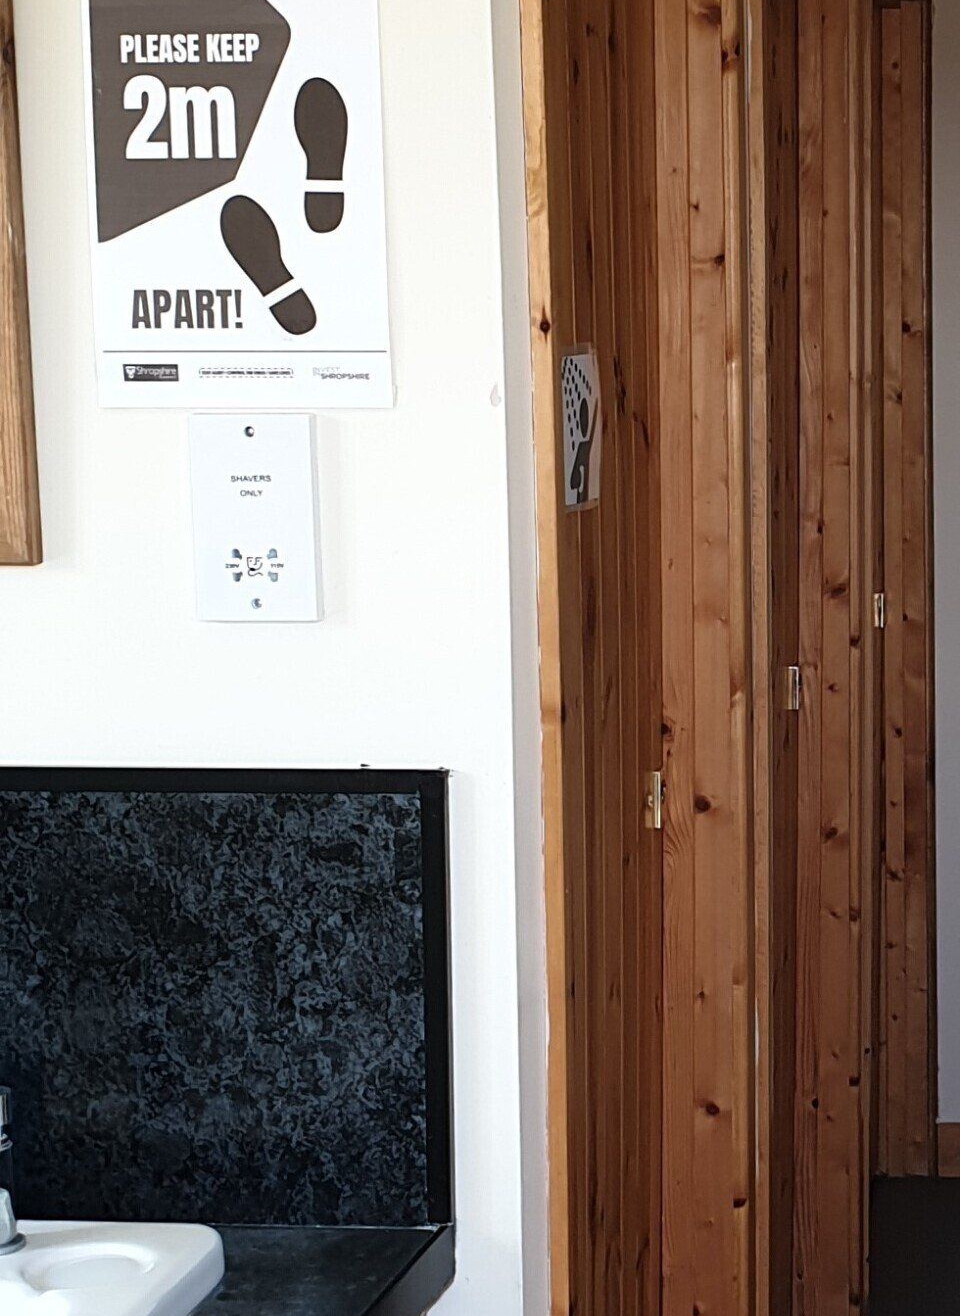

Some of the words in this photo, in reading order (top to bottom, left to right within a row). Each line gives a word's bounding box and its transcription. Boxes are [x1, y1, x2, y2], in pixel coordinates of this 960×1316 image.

[119, 34, 200, 64] PLEASE
[205, 33, 261, 63] KEEP
[122, 74, 238, 161] 2m
[131, 288, 245, 330] APART!
[320, 372, 370, 381] SHROPSHIRE
[230, 474, 272, 483] SHAVERS
[239, 489, 263, 498] ONLY
